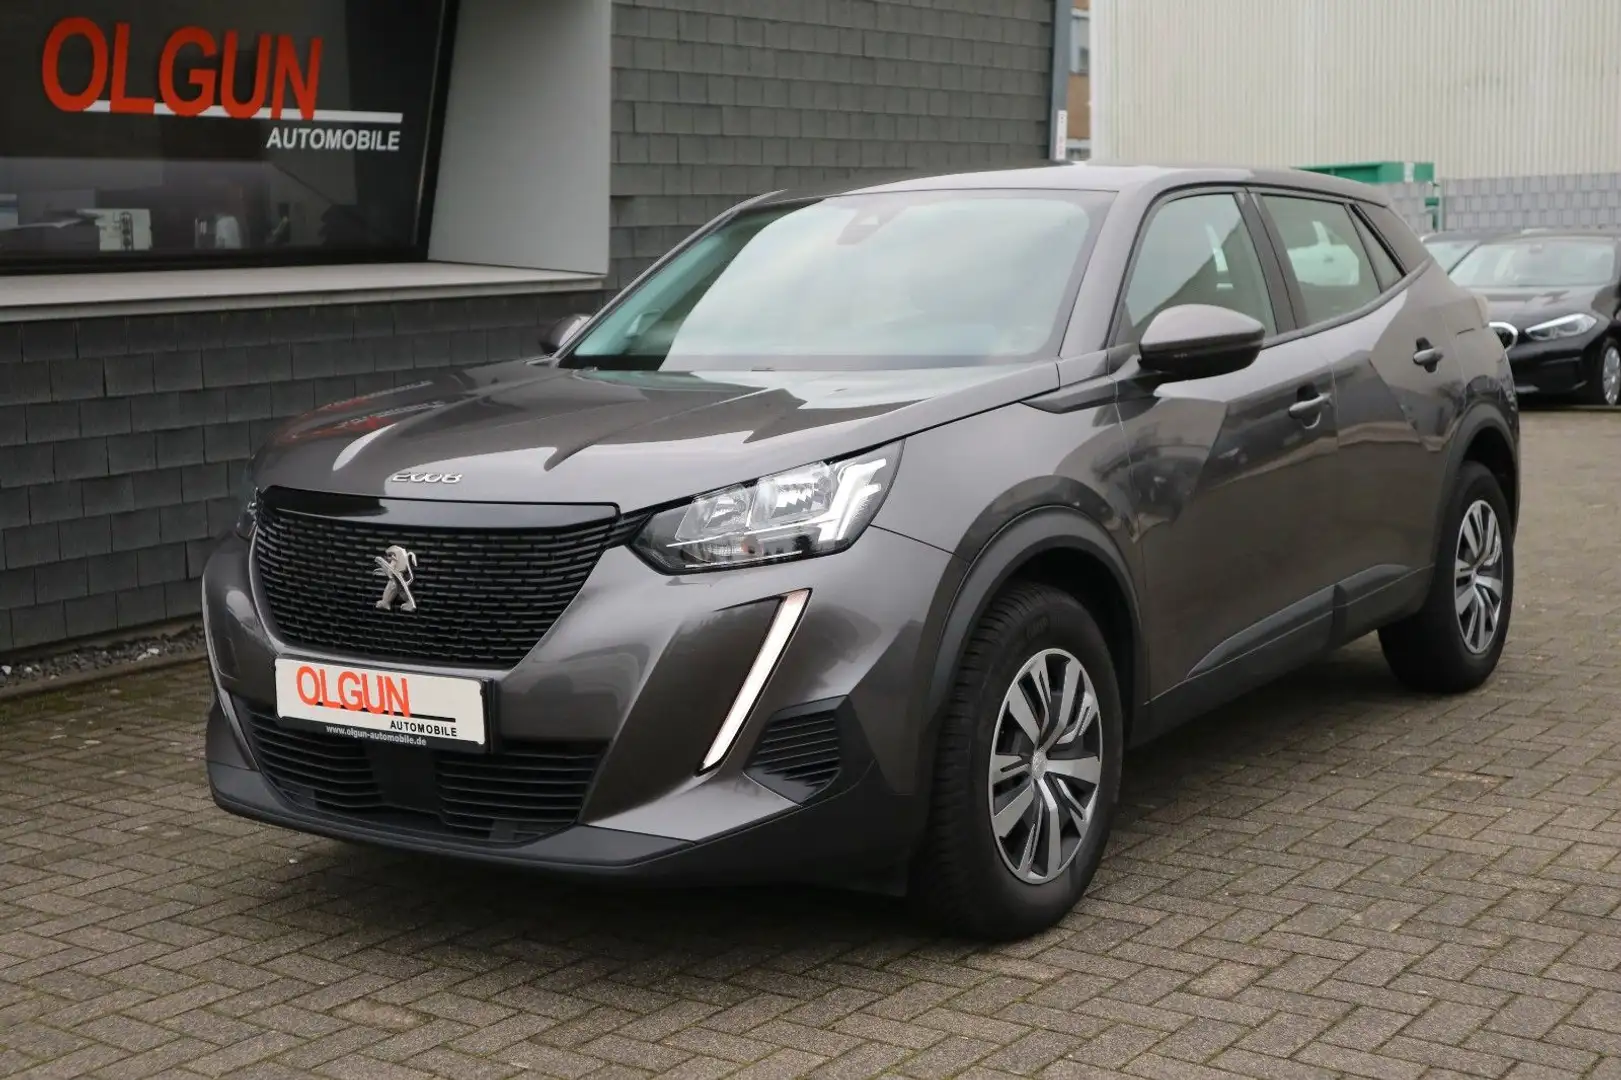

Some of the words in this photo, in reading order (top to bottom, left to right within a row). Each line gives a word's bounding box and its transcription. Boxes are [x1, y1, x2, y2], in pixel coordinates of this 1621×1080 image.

[42, 16, 323, 120] OLGUN
[266, 127, 400, 151] AUTOMOBILE
[392, 472, 462, 484] 2008
[296, 665, 411, 718] OLGUN
[326, 724, 427, 746] www.olgun-automobile.de
[390, 720, 457, 737] AUTOMOBILE
